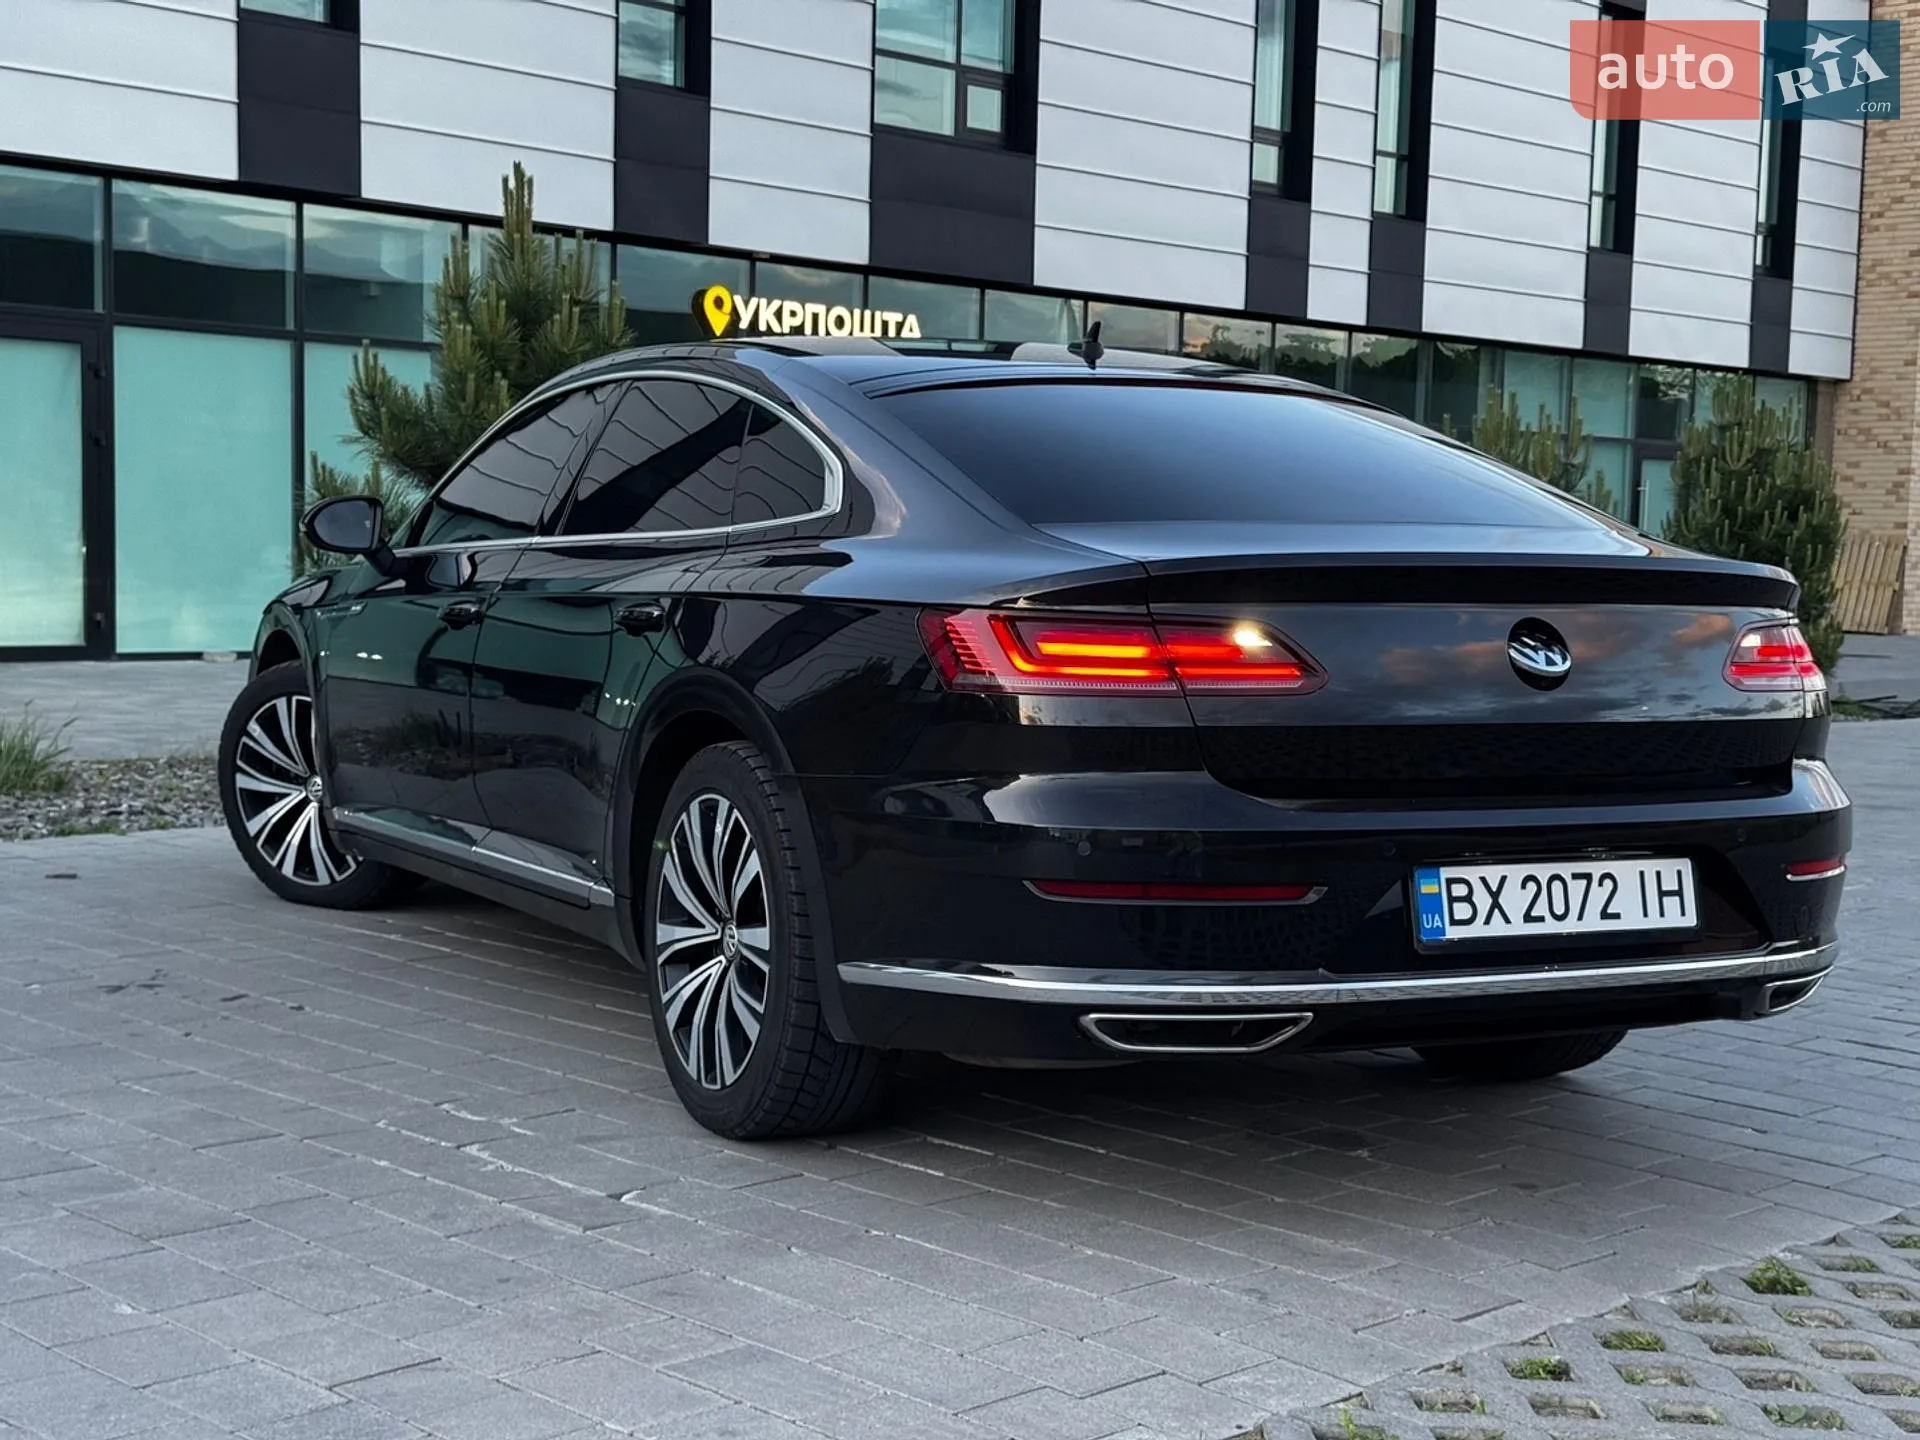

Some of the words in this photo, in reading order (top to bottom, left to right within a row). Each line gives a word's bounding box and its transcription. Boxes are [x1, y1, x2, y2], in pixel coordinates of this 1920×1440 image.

[732, 294, 922, 338] УКРПОШТА
[1445, 874, 1512, 927] BX
[1520, 872, 1621, 923] 2072
[1638, 869, 1686, 918] IH
[1422, 913, 1442, 929] UA
